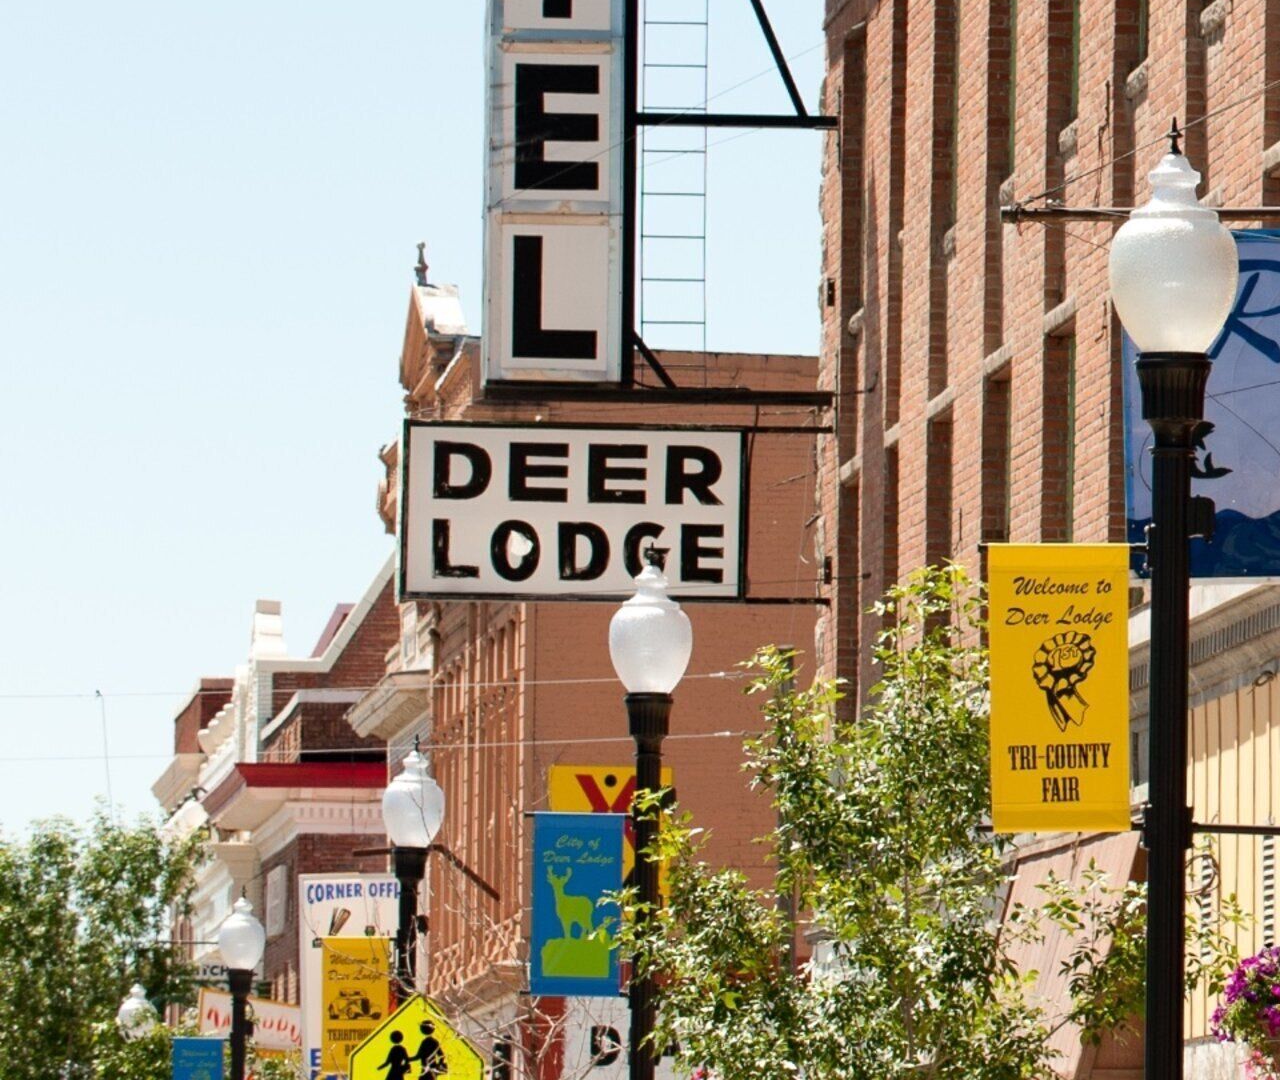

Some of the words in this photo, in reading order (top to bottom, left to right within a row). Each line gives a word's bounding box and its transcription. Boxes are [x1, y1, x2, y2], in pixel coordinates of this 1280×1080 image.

[432, 440, 725, 506] DEER
[431, 518, 725, 584] LODGE
[1013, 576, 1089, 595] Welcome
[1096, 579, 1113, 594] to
[1005, 607, 1050, 626] Deer
[1056, 604, 1113, 630] Lodge
[1008, 743, 1111, 771] TRI-COUNTY
[1041, 776, 1081, 803] FAIR
[555, 834, 584, 850] City
[588, 837, 602, 851] of
[307, 882, 362, 904] CORNER
